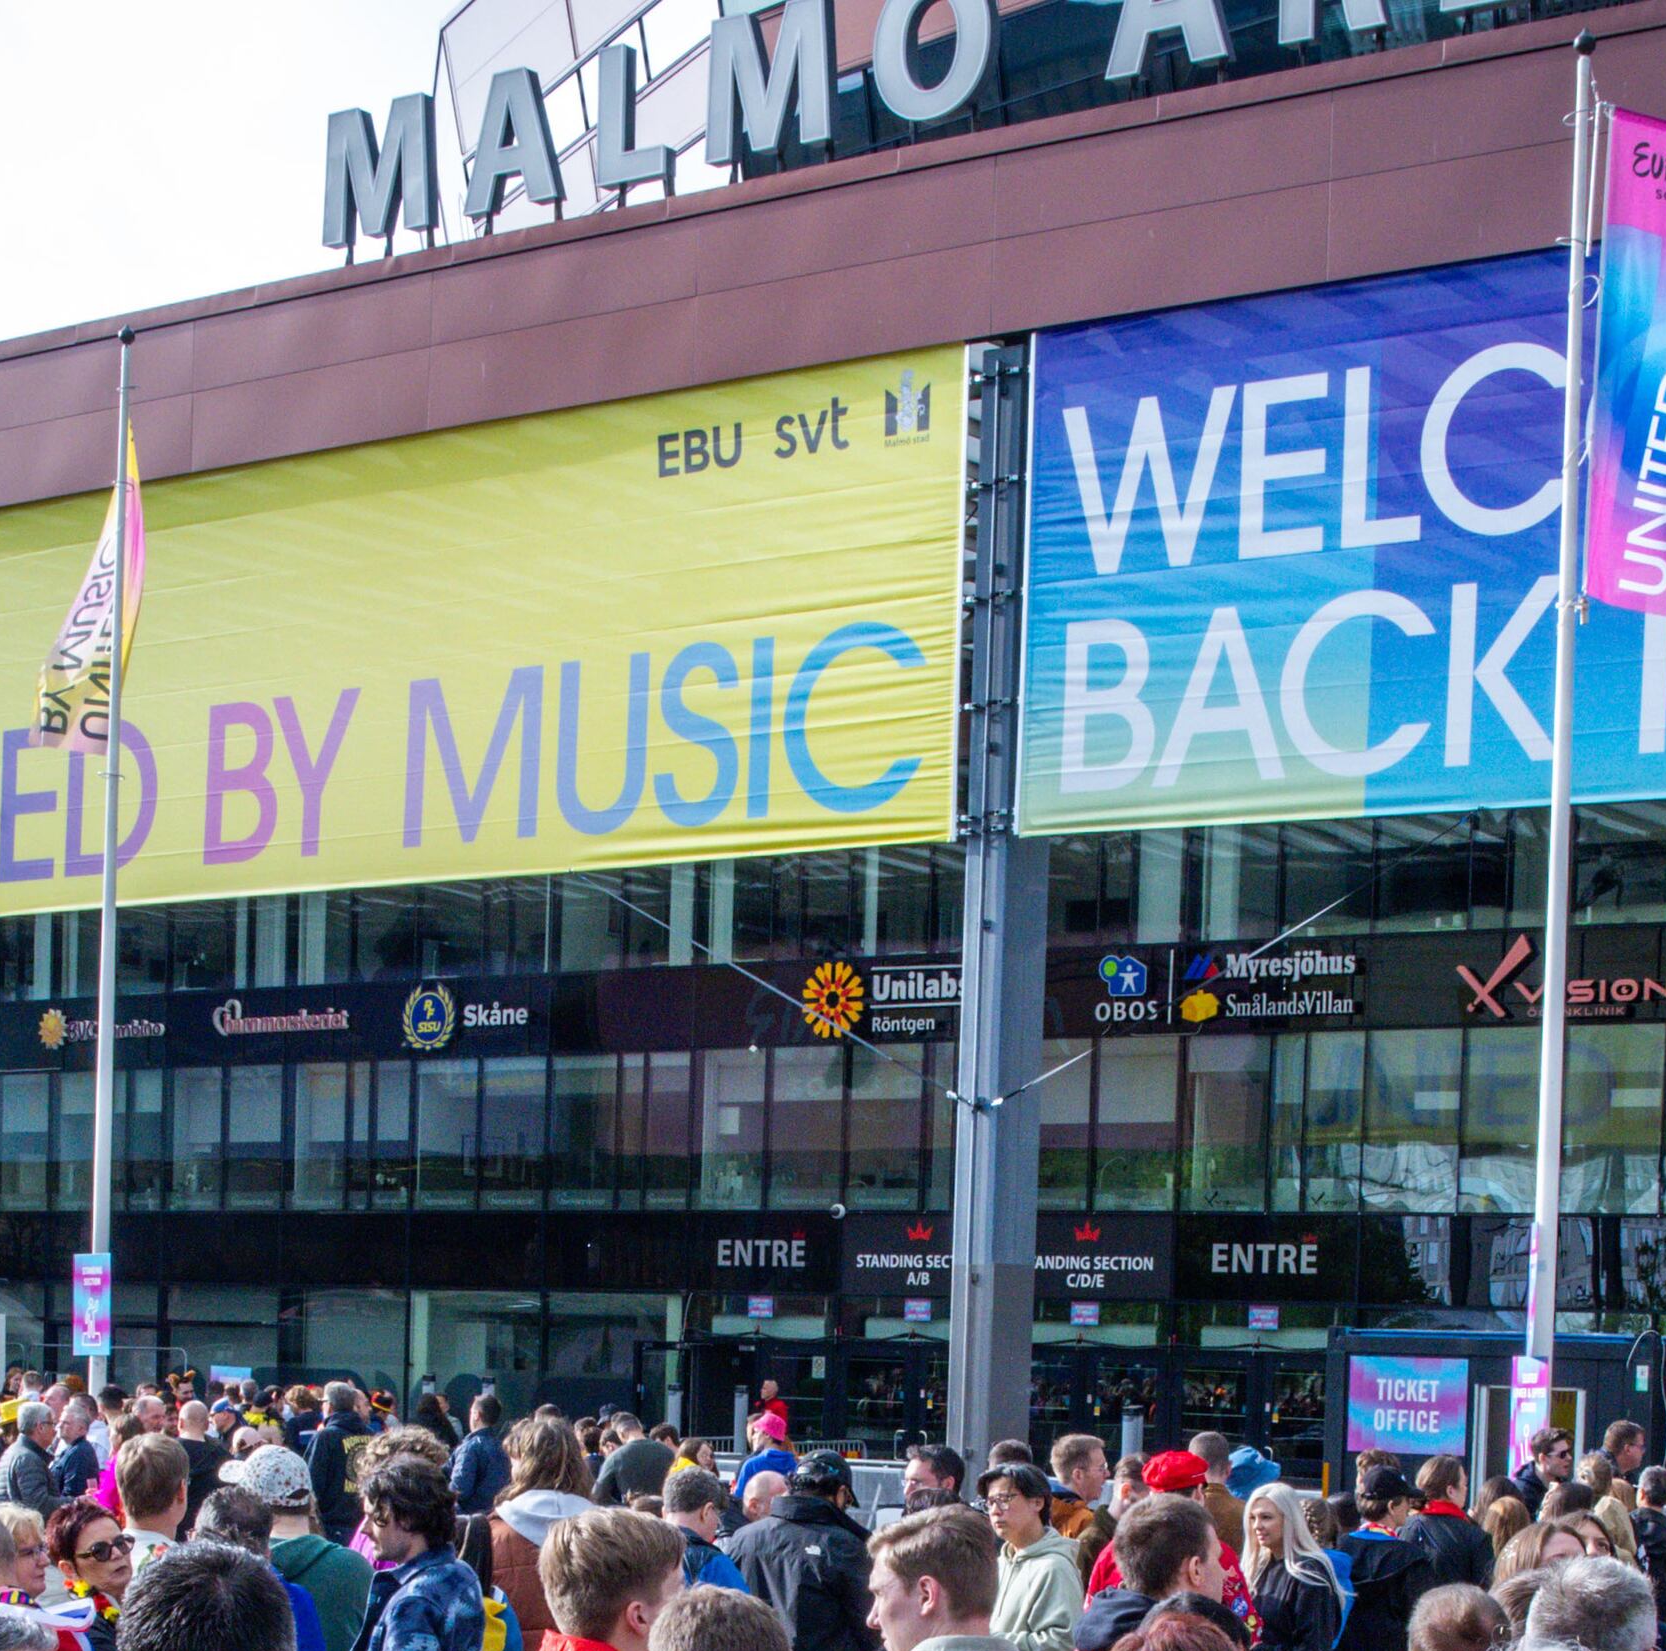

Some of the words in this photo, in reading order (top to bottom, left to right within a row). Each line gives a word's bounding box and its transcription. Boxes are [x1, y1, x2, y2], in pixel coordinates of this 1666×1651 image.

[657, 421, 744, 480] EBU
[774, 396, 852, 462] svt
[1059, 574, 1557, 794] BACK
[202, 686, 362, 866] BY
[402, 620, 929, 849] MUSIC
[1225, 950, 1357, 983] Myresjöhus
[462, 1001, 529, 1027] Skåne
[1094, 1000, 1159, 1022] OBOS
[1225, 989, 1354, 1018] SmålandsVillan
[417, 1021, 442, 1033] SISU
[871, 1016, 936, 1034] Röntgen
[855, 1254, 923, 1269] STANDING
[1033, 1255, 1091, 1271] ANDING
[1093, 1256, 1154, 1271] SECTION
[906, 1272, 931, 1286] A/B
[1066, 1273, 1105, 1289] C/D/E
[1376, 1377, 1440, 1403] TICKET
[1373, 1408, 1441, 1434] OFFICE
